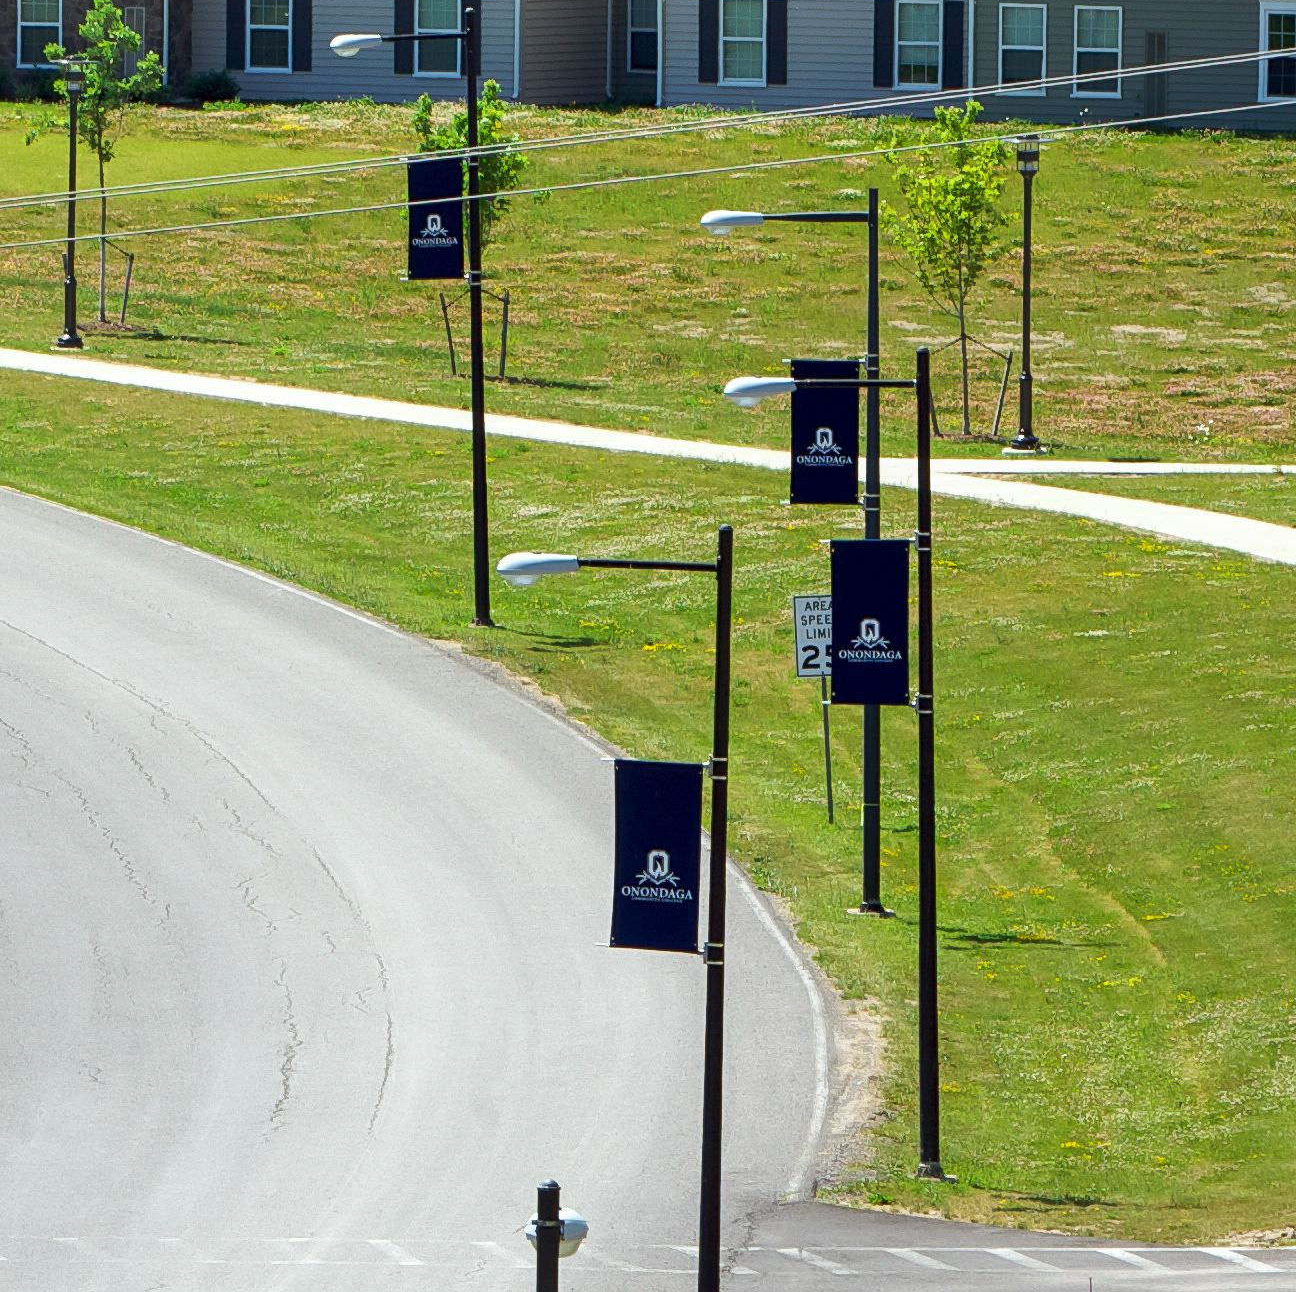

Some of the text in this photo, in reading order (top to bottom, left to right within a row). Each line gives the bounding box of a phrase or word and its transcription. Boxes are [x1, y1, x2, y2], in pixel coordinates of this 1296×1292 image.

[412, 237, 458, 246] ONONDAGA
[796, 455, 853, 464] ONONDAGA
[805, 601, 832, 611] AREA
[801, 615, 832, 626] SPEE
[806, 628, 832, 639] LIMI
[838, 649, 902, 659] ONONDAGA
[621, 886, 693, 900] ONONDAGA
